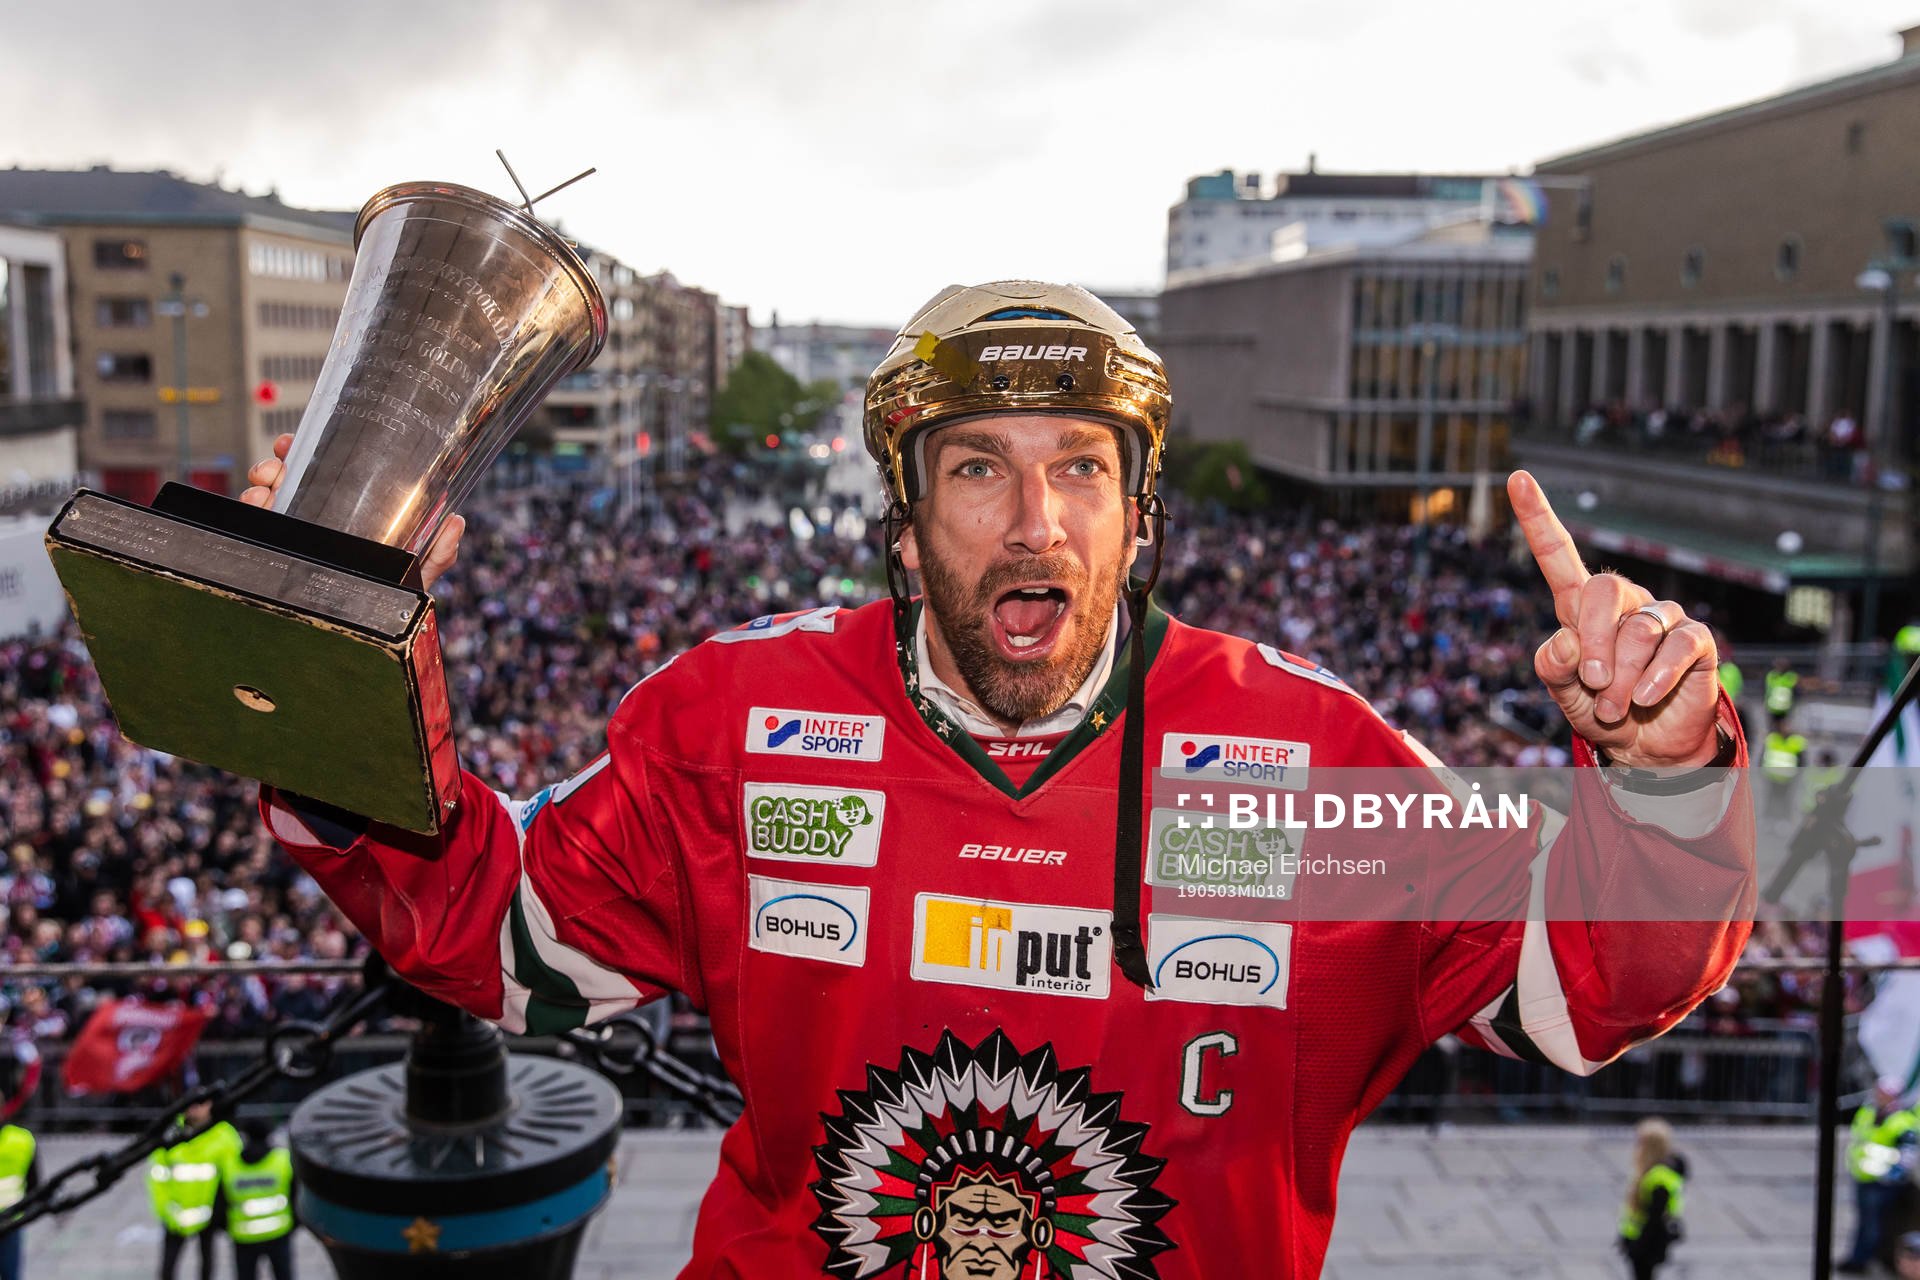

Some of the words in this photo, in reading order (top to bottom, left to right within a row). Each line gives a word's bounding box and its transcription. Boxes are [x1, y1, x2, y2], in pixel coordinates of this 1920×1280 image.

[805, 718, 865, 737] INTER
[801, 735, 863, 754] SPORT
[987, 742, 1052, 757] SHL
[1225, 743, 1289, 764] INTER
[1223, 761, 1288, 782] SPORT
[755, 799, 829, 827] CASH
[755, 825, 850, 854] BUDDY
[1164, 827, 1249, 858] CASH
[766, 915, 840, 941] BOHUS
[1175, 960, 1262, 983] BOHUS
[1179, 1029, 1239, 1118] C
